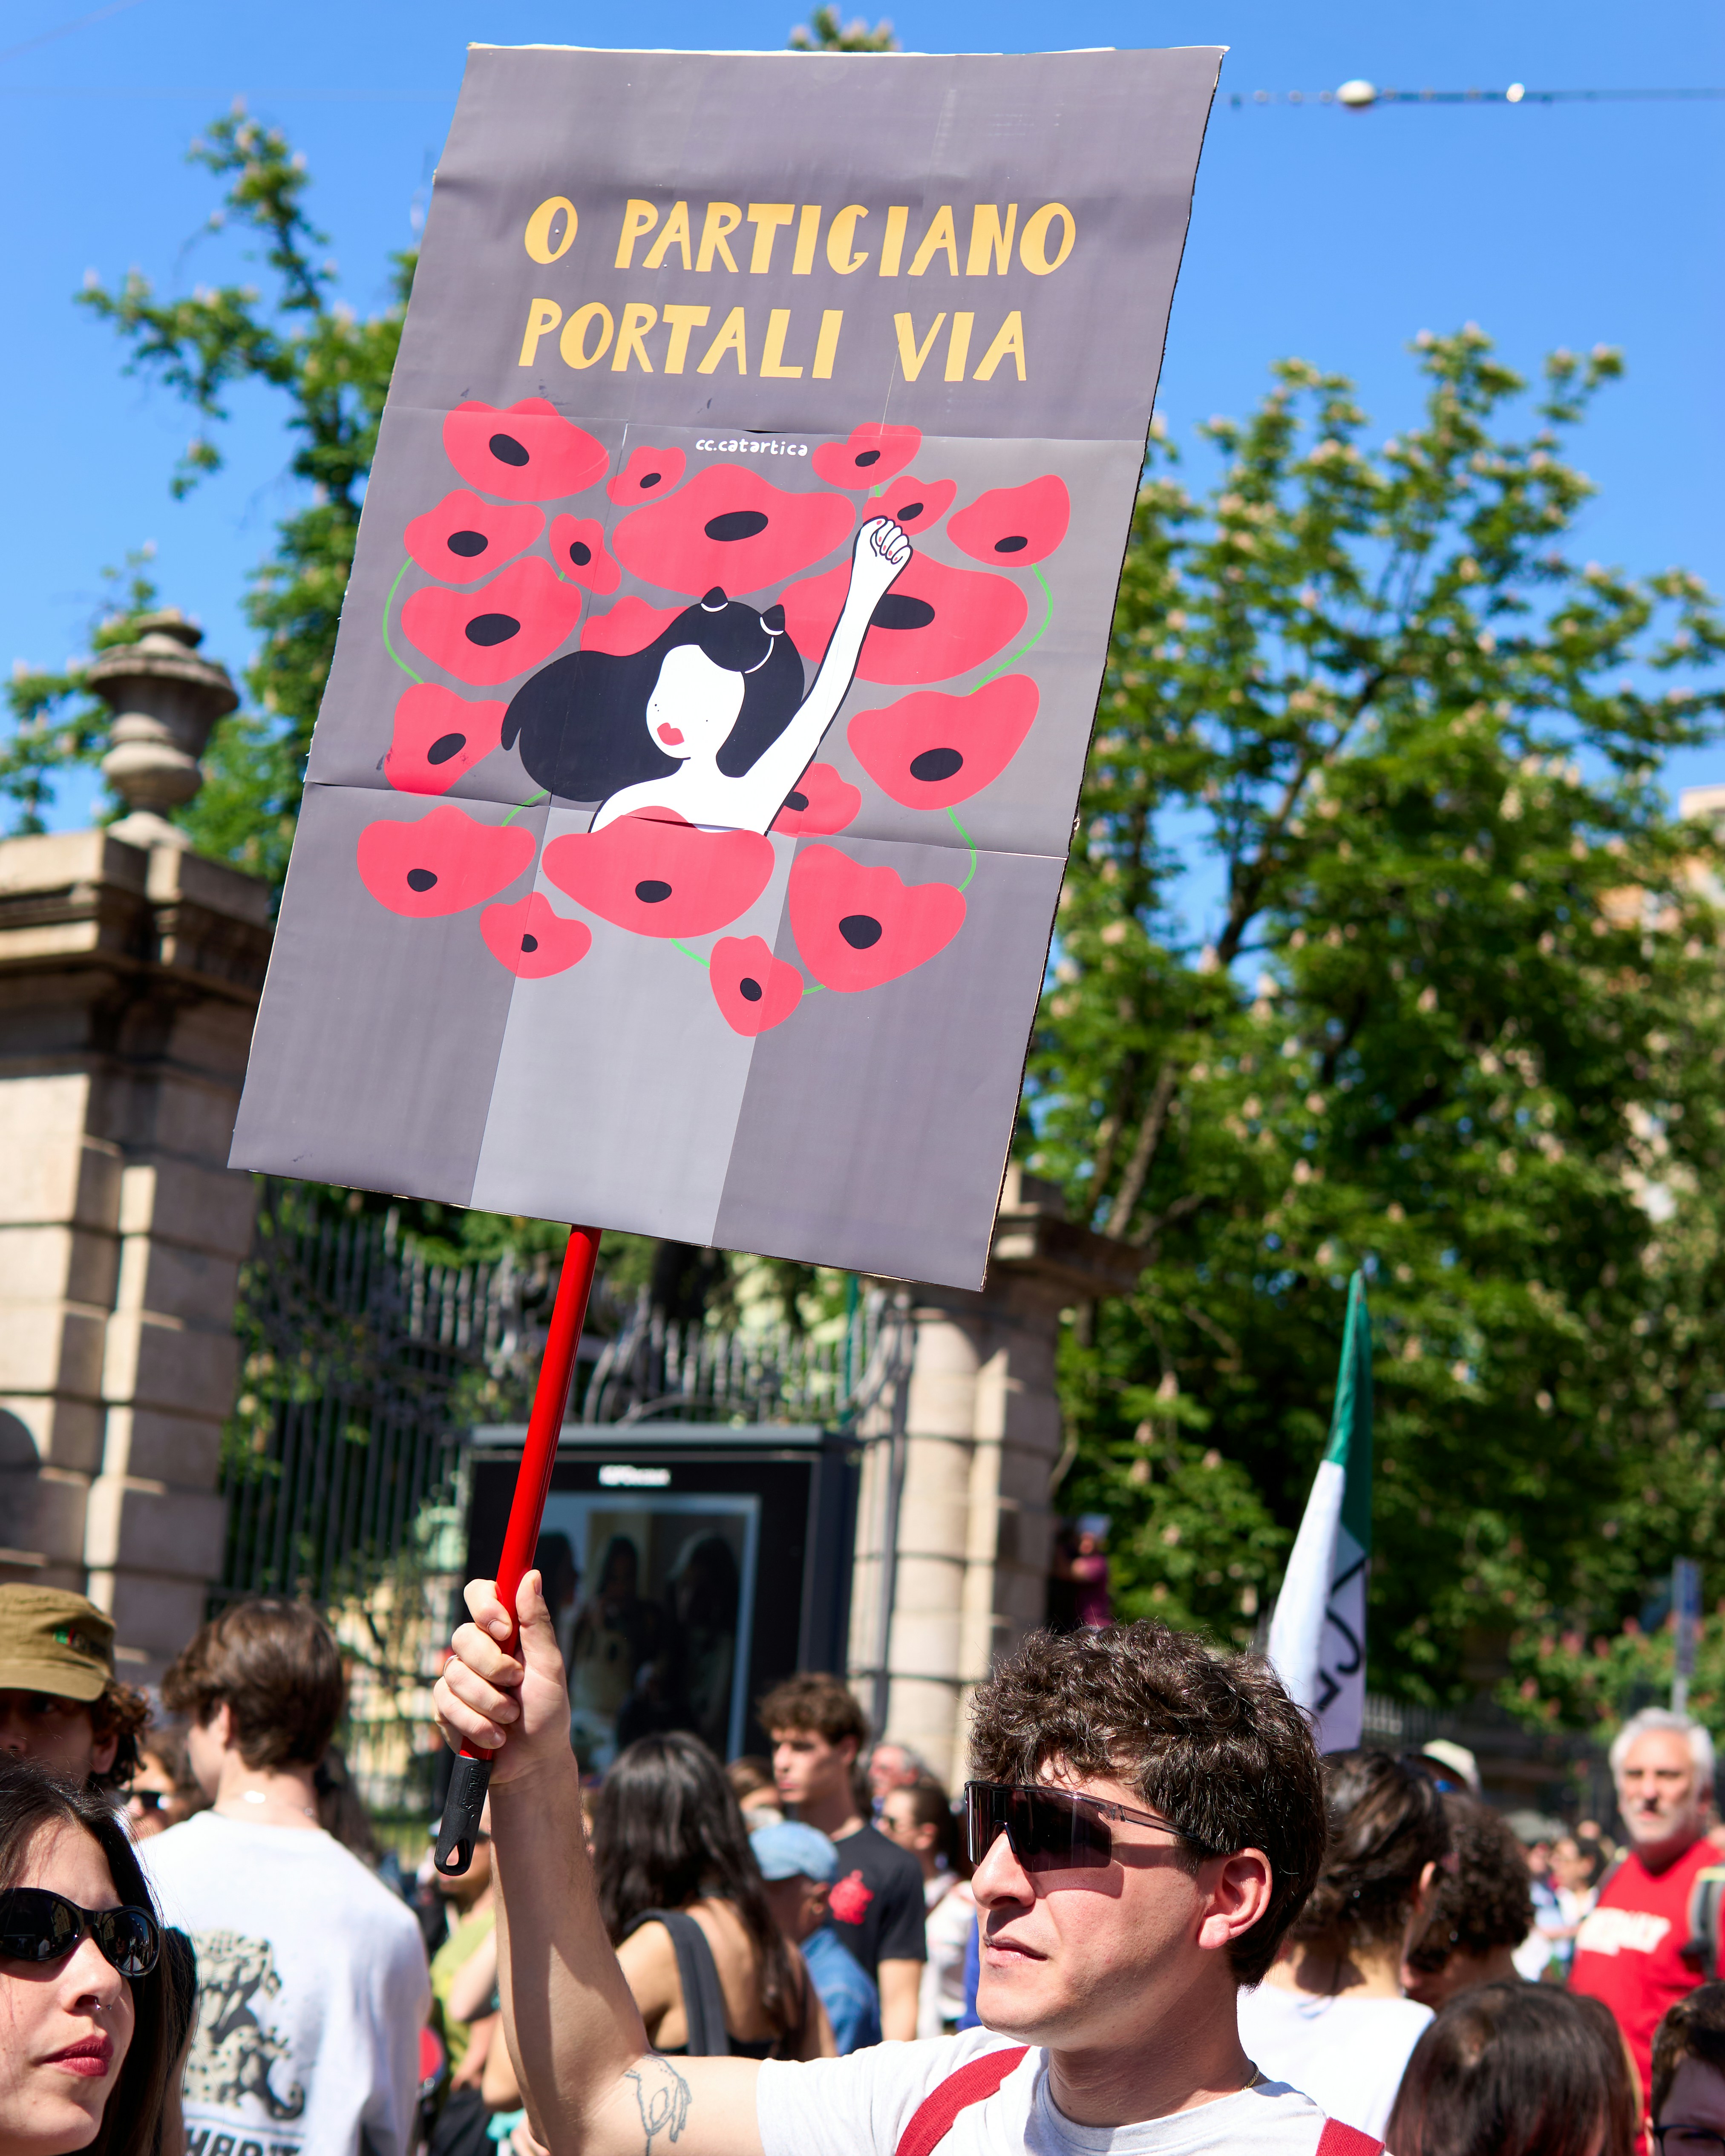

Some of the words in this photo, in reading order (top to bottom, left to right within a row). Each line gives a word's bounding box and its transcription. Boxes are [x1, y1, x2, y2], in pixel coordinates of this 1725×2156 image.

[524, 196, 579, 265] O
[614, 199, 1076, 277] PARTIGIANO
[518, 298, 844, 379] PORTALI
[893, 311, 1027, 382] VIA
[695, 438, 808, 456] cc.catartica
